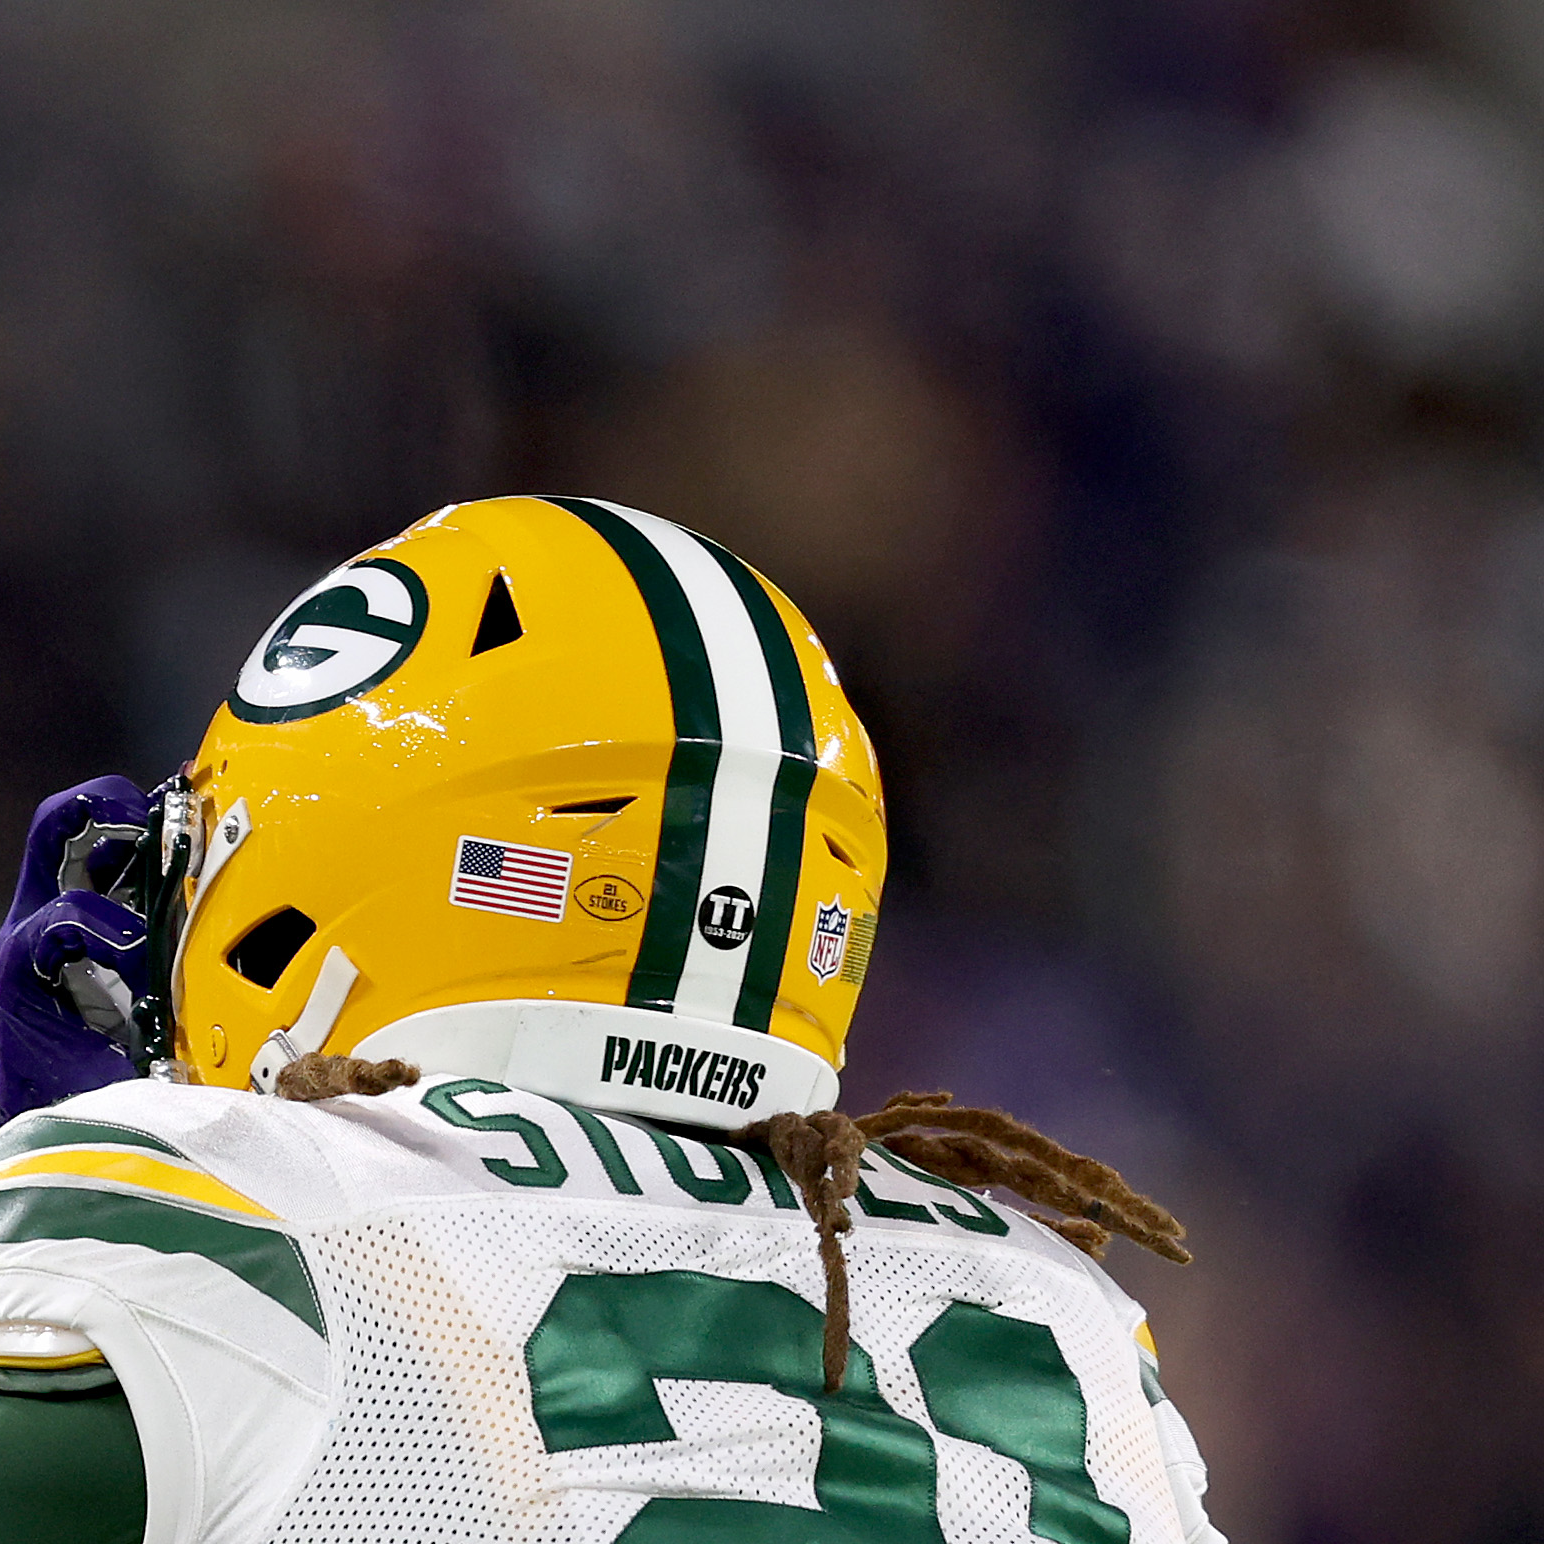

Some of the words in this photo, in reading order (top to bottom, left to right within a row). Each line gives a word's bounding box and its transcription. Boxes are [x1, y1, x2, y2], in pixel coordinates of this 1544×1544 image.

[588, 894, 628, 913] STOKES
[603, 883, 617, 897] 21
[709, 894, 751, 930] TT
[813, 934, 840, 970] NFL
[601, 1035, 767, 1110] PACKERS
